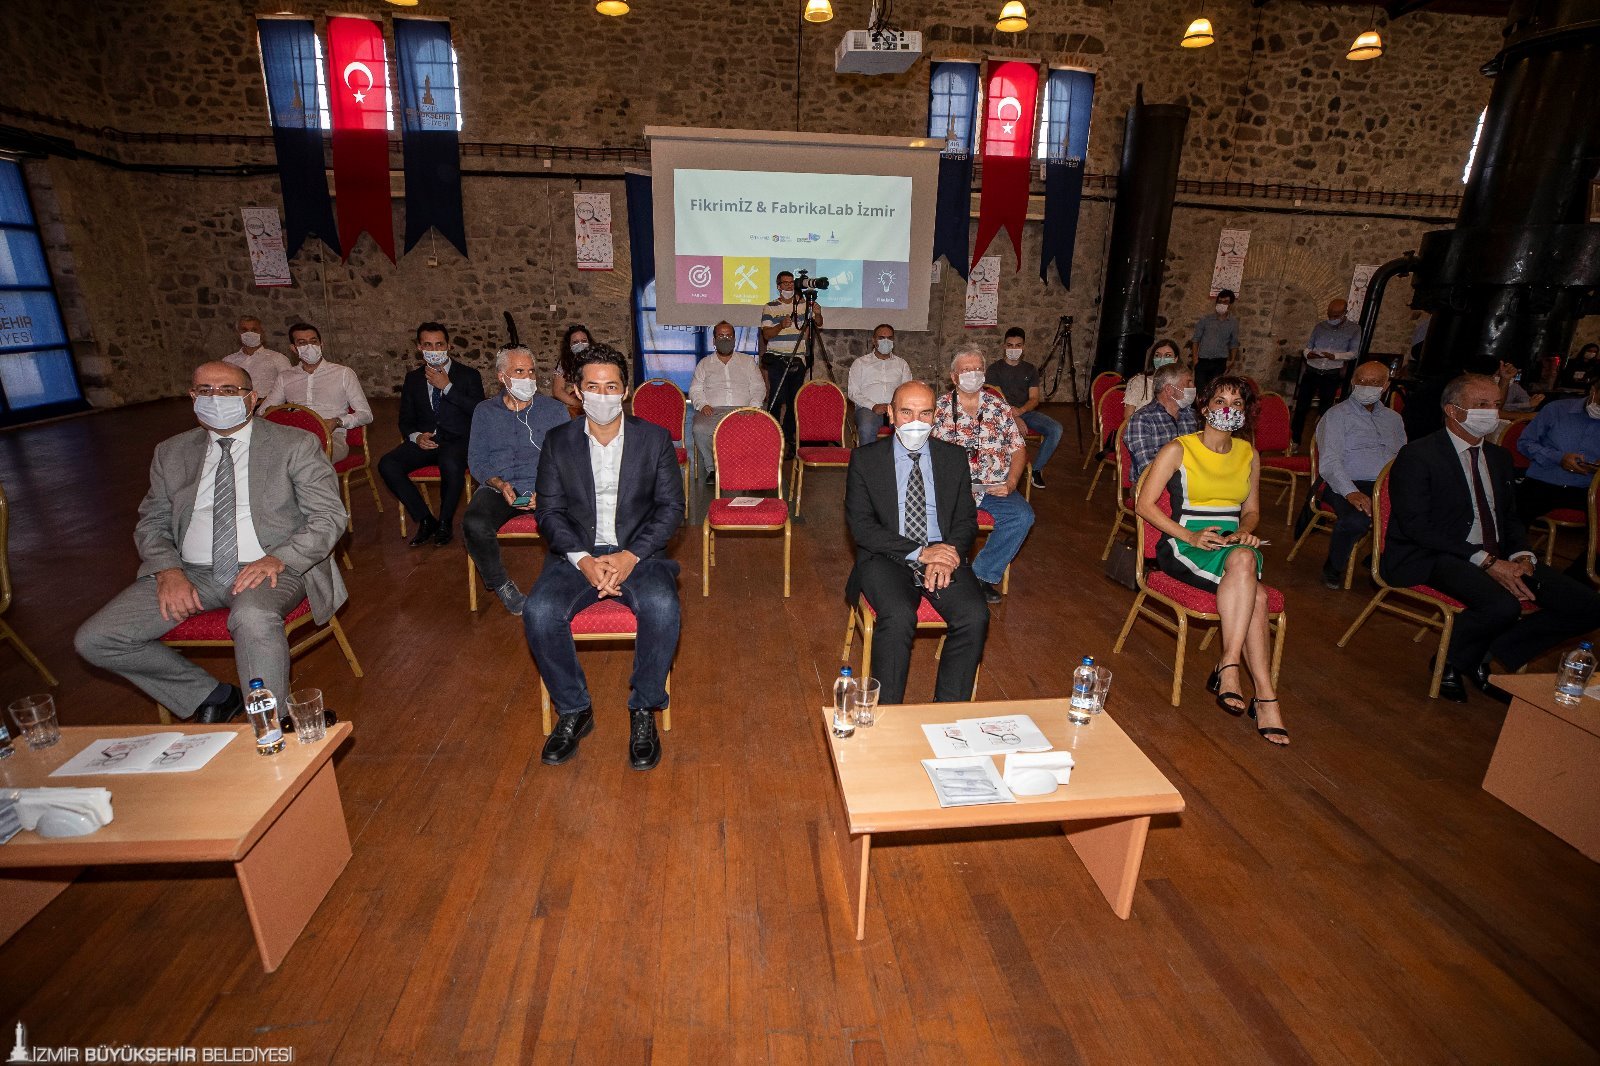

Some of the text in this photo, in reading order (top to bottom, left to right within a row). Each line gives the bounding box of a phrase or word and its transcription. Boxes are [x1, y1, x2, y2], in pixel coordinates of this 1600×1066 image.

[690, 198, 896, 217] FikrimİZ & FabrikaLab İzmir
